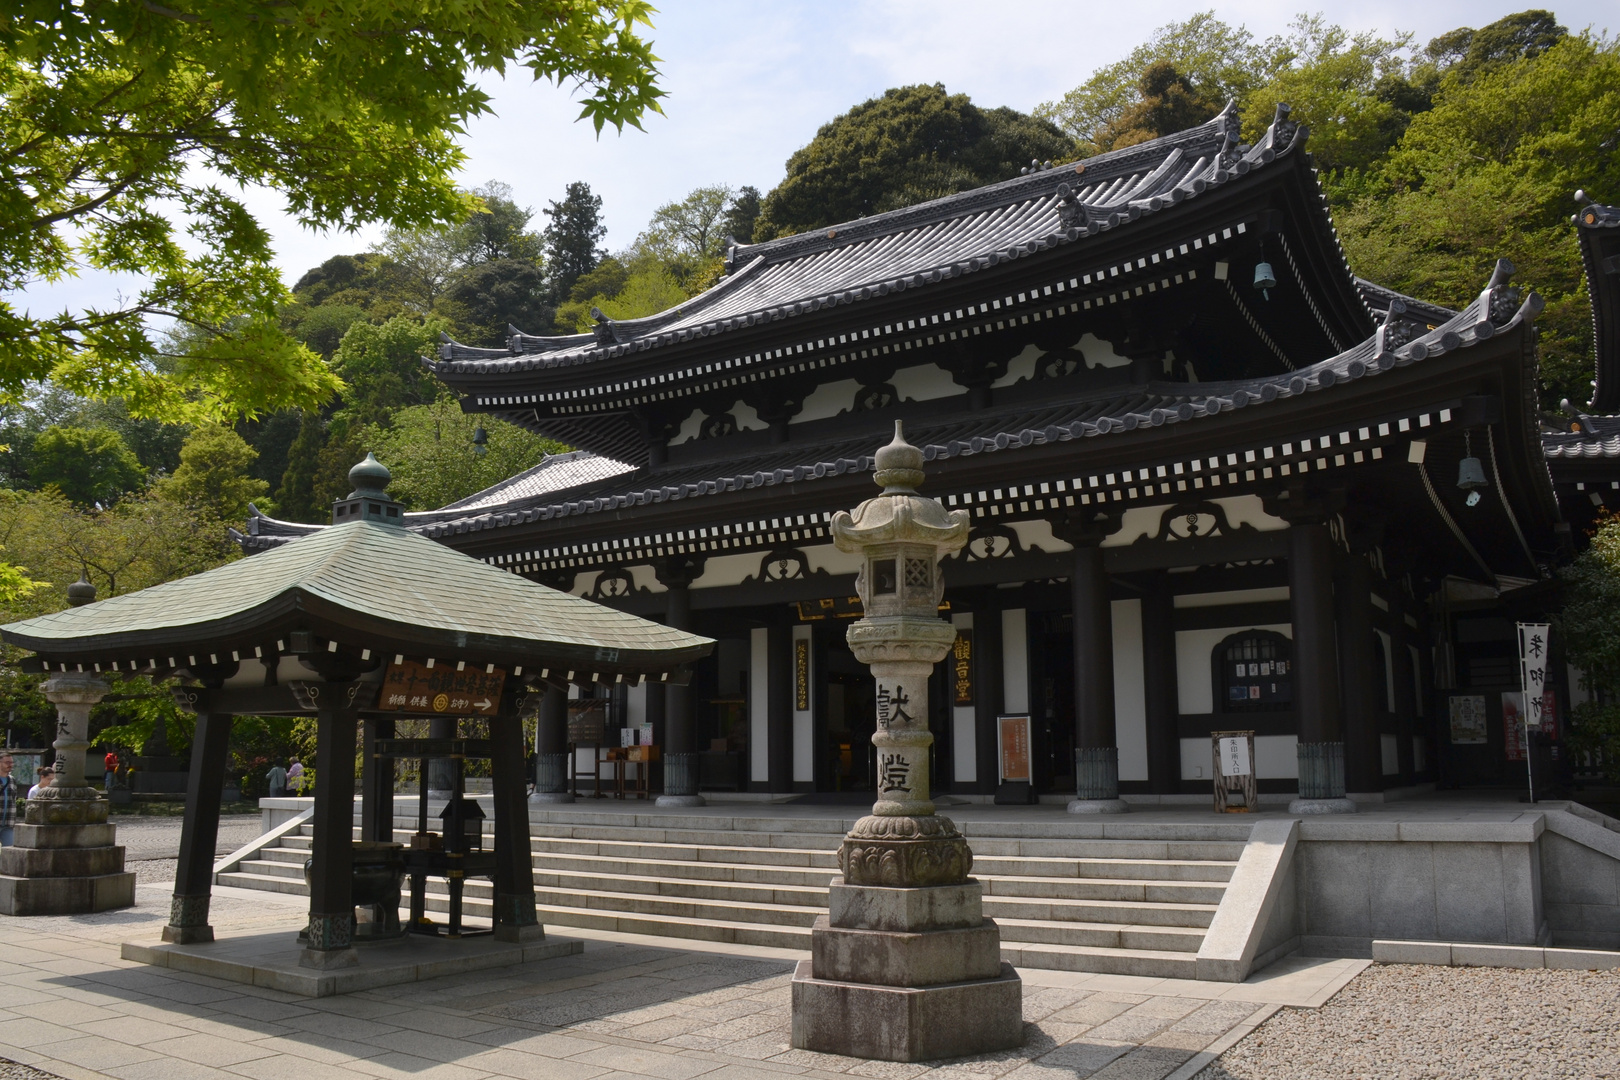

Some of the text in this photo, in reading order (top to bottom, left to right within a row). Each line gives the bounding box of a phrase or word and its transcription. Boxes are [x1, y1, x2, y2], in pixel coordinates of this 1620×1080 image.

[450, 698, 469, 709] お守り
[1229, 739, 1240, 774] 朱印所入口
